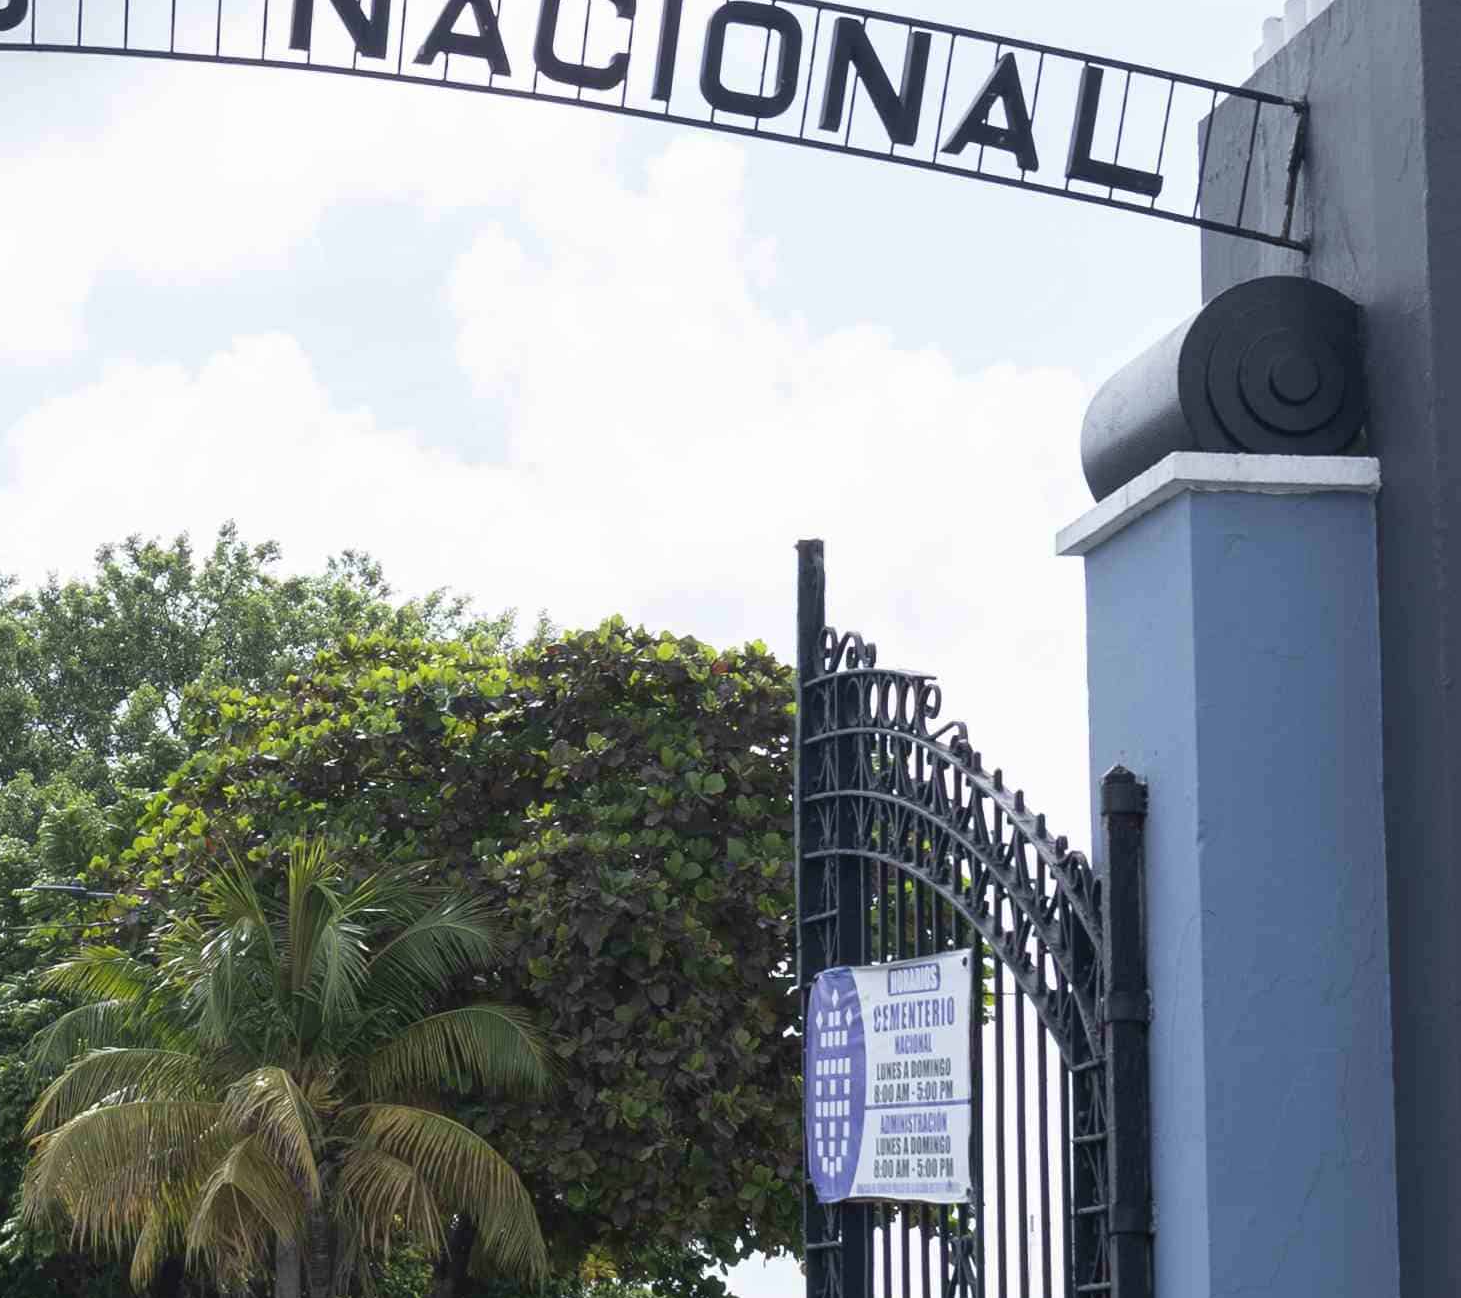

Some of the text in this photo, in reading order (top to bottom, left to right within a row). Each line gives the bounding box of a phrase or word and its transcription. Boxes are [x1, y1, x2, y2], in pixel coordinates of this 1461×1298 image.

[873, 996, 955, 1033] CEMENTERIO
[895, 1033, 932, 1054] NACIONAL
[876, 1057, 951, 1081] LUNES A DOMINGO
[874, 1083, 894, 1103] 8:00
[896, 1083, 910, 1102] AM
[917, 1081, 937, 1101] 5:00
[940, 1079, 953, 1100] PM
[876, 1135, 951, 1156] LUNES A DOMINGO
[873, 1159, 894, 1179] 8:00
[896, 1158, 910, 1178] AM
[917, 1157, 938, 1178] 5:00
[940, 1157, 954, 1178] PM
